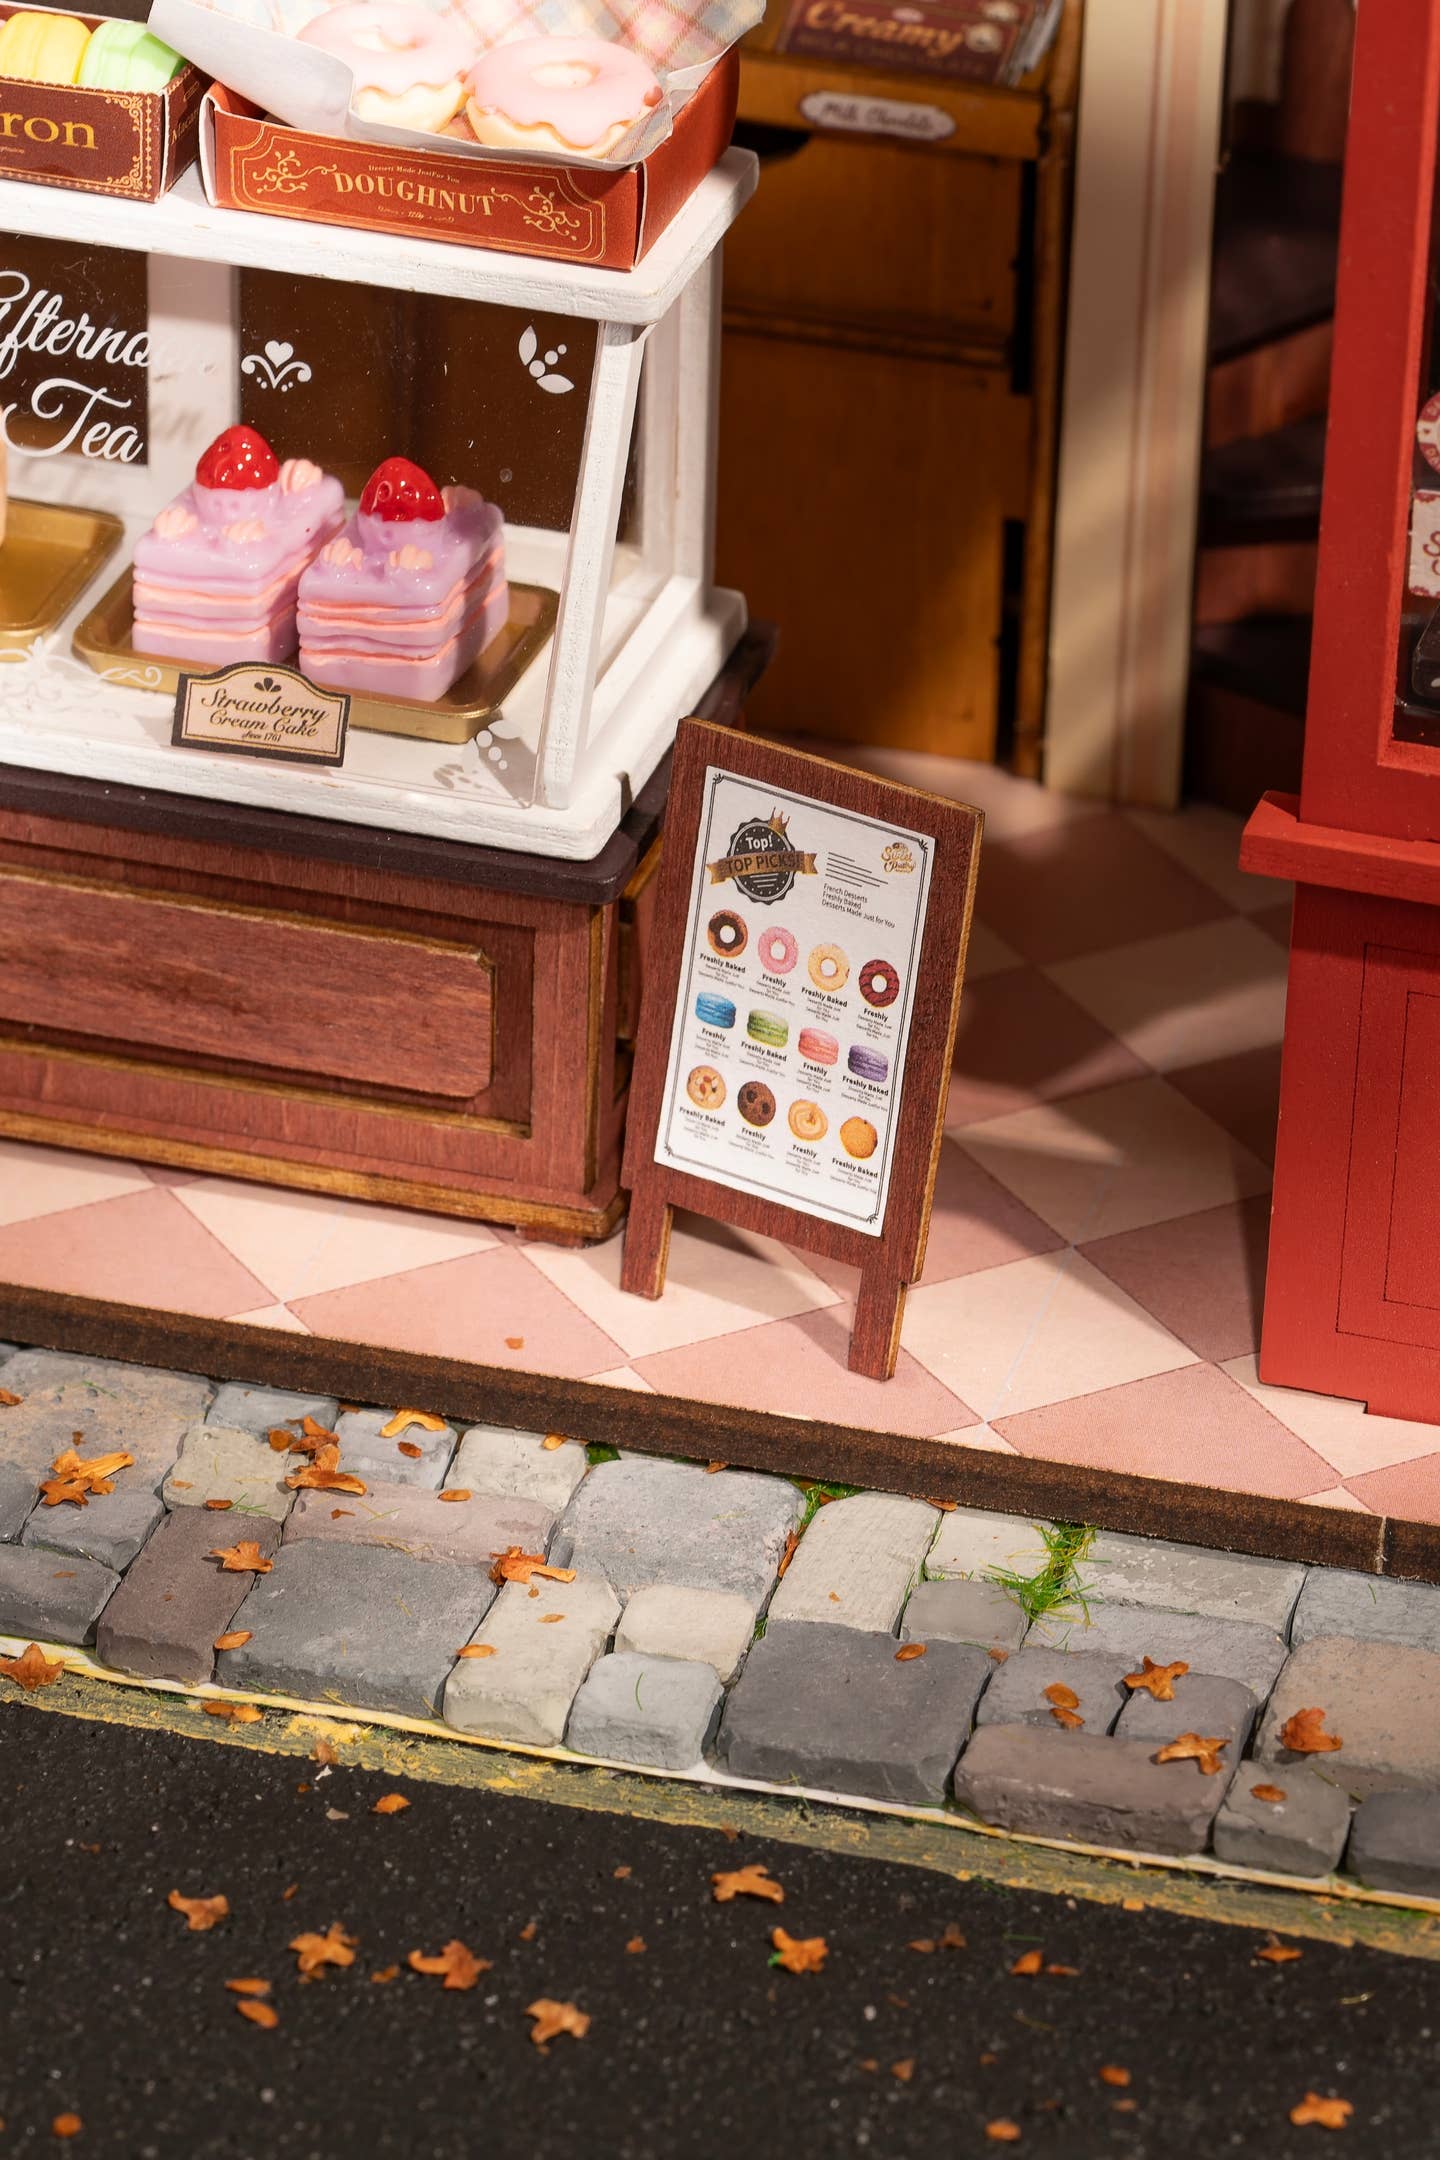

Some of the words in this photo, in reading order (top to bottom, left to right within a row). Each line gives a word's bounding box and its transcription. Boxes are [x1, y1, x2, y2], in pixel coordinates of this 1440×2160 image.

[804, 2, 963, 57] Creamy
[334, 172, 495, 216] DOUGHNUT
[1, 378, 144, 463] Tea
[200, 688, 330, 727] Strawberry
[209, 709, 269, 730] Cream
[272, 717, 319, 738] Cake
[745, 835, 773, 851] Top!
[726, 857, 753, 874] TOP
[823, 883, 843, 895] French
[844, 890, 868, 903] Desserts
[823, 891, 843, 904] Freshly
[821, 899, 845, 912] Desserts
[847, 907, 862, 917] Made
[863, 913, 875, 922] Just
[875, 915, 884, 924] for
[884, 920, 896, 929] You
[700, 953, 724, 967] Freshly
[725, 961, 746, 974] Baked
[762, 973, 787, 988] Freshly
[801, 987, 826, 1001] Freshly
[827, 994, 848, 1008] Baked
[863, 1007, 888, 1022] Freshly
[702, 1028, 726, 1041] Freshly
[741, 1041, 765, 1055] Freshly
[766, 1048, 787, 1062] Baked
[803, 1062, 828, 1076] Freshly
[842, 1075, 867, 1089] Freshly
[868, 1083, 889, 1096] Baked
[741, 1127, 766, 1141] Freshly
[792, 1144, 817, 1158] Freshly
[832, 1158, 857, 1172] Freshly
[857, 1165, 878, 1178] Baked
